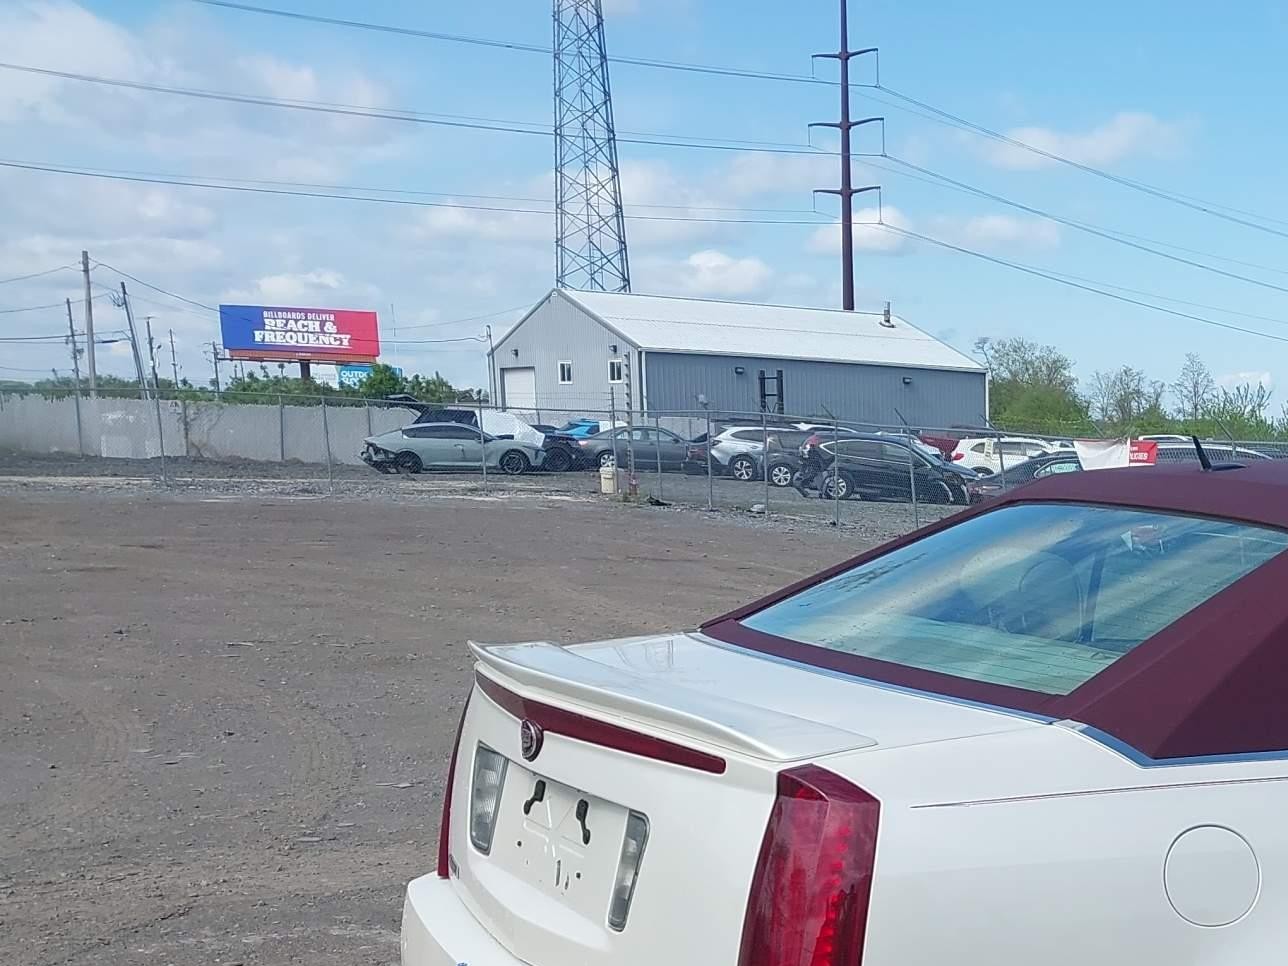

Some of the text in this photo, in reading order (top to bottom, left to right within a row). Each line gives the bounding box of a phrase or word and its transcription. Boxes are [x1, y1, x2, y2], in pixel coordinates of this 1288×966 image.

[264, 311, 334, 321] BILLBOARDS DELIVER
[265, 319, 337, 333] REACH &
[254, 331, 351, 346] FREQUENCY
